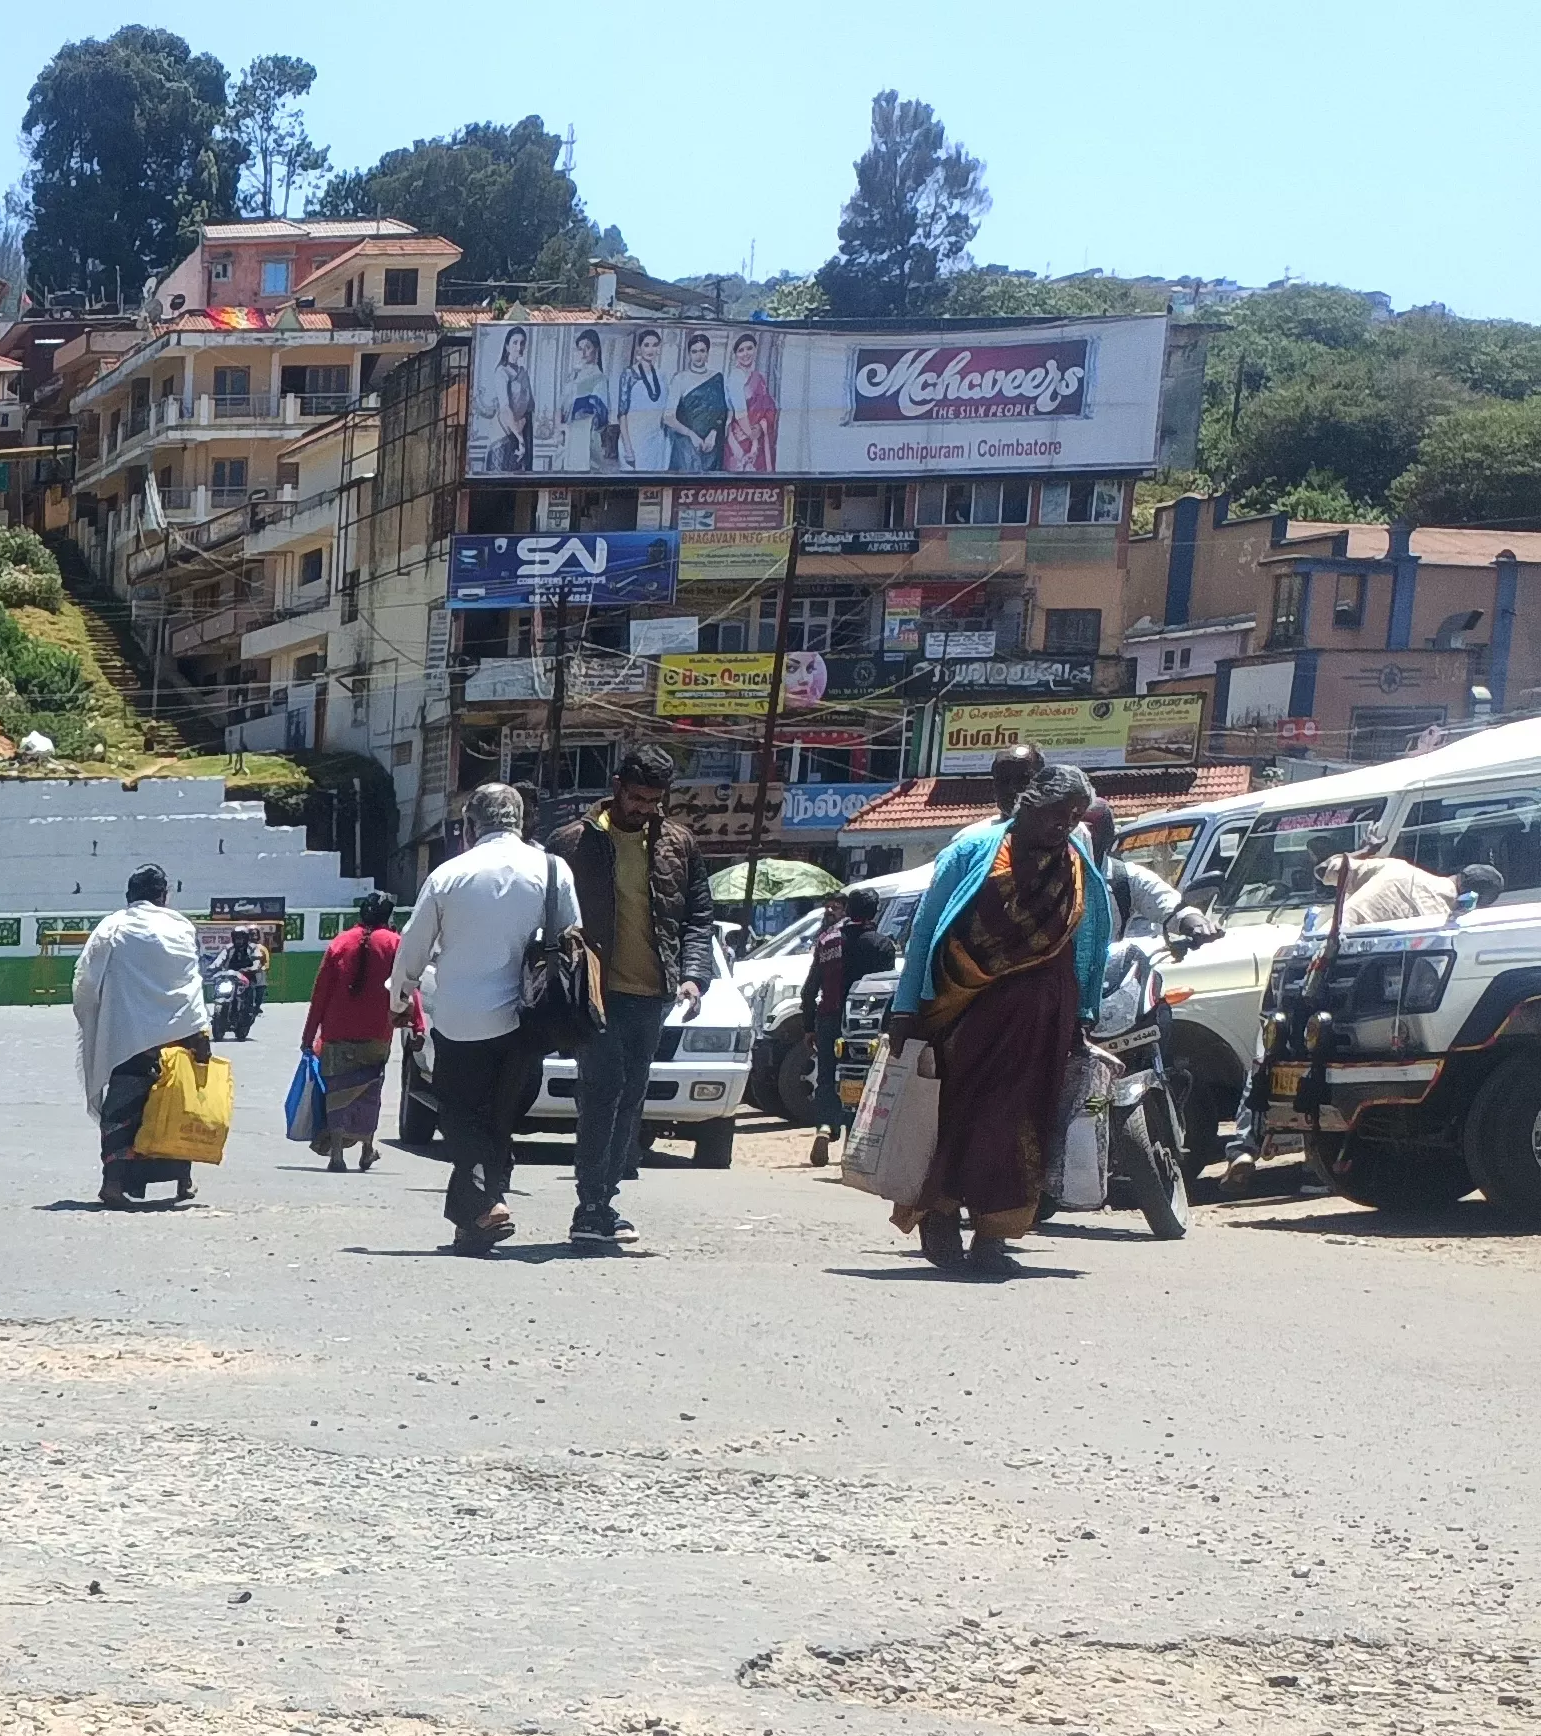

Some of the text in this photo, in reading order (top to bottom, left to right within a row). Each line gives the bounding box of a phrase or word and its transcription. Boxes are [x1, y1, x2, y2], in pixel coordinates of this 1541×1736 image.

[856, 349, 1085, 416] Mahaveers
[932, 403, 1035, 419] THE SILK PEOPLE
[867, 438, 1062, 464] Gandhipuram Coimbatore
[678, 488, 780, 503] SS COMPUTERS
[681, 531, 736, 544] BHAGAVAN
[739, 531, 763, 543] INFO
[681, 668, 717, 687] BEST
